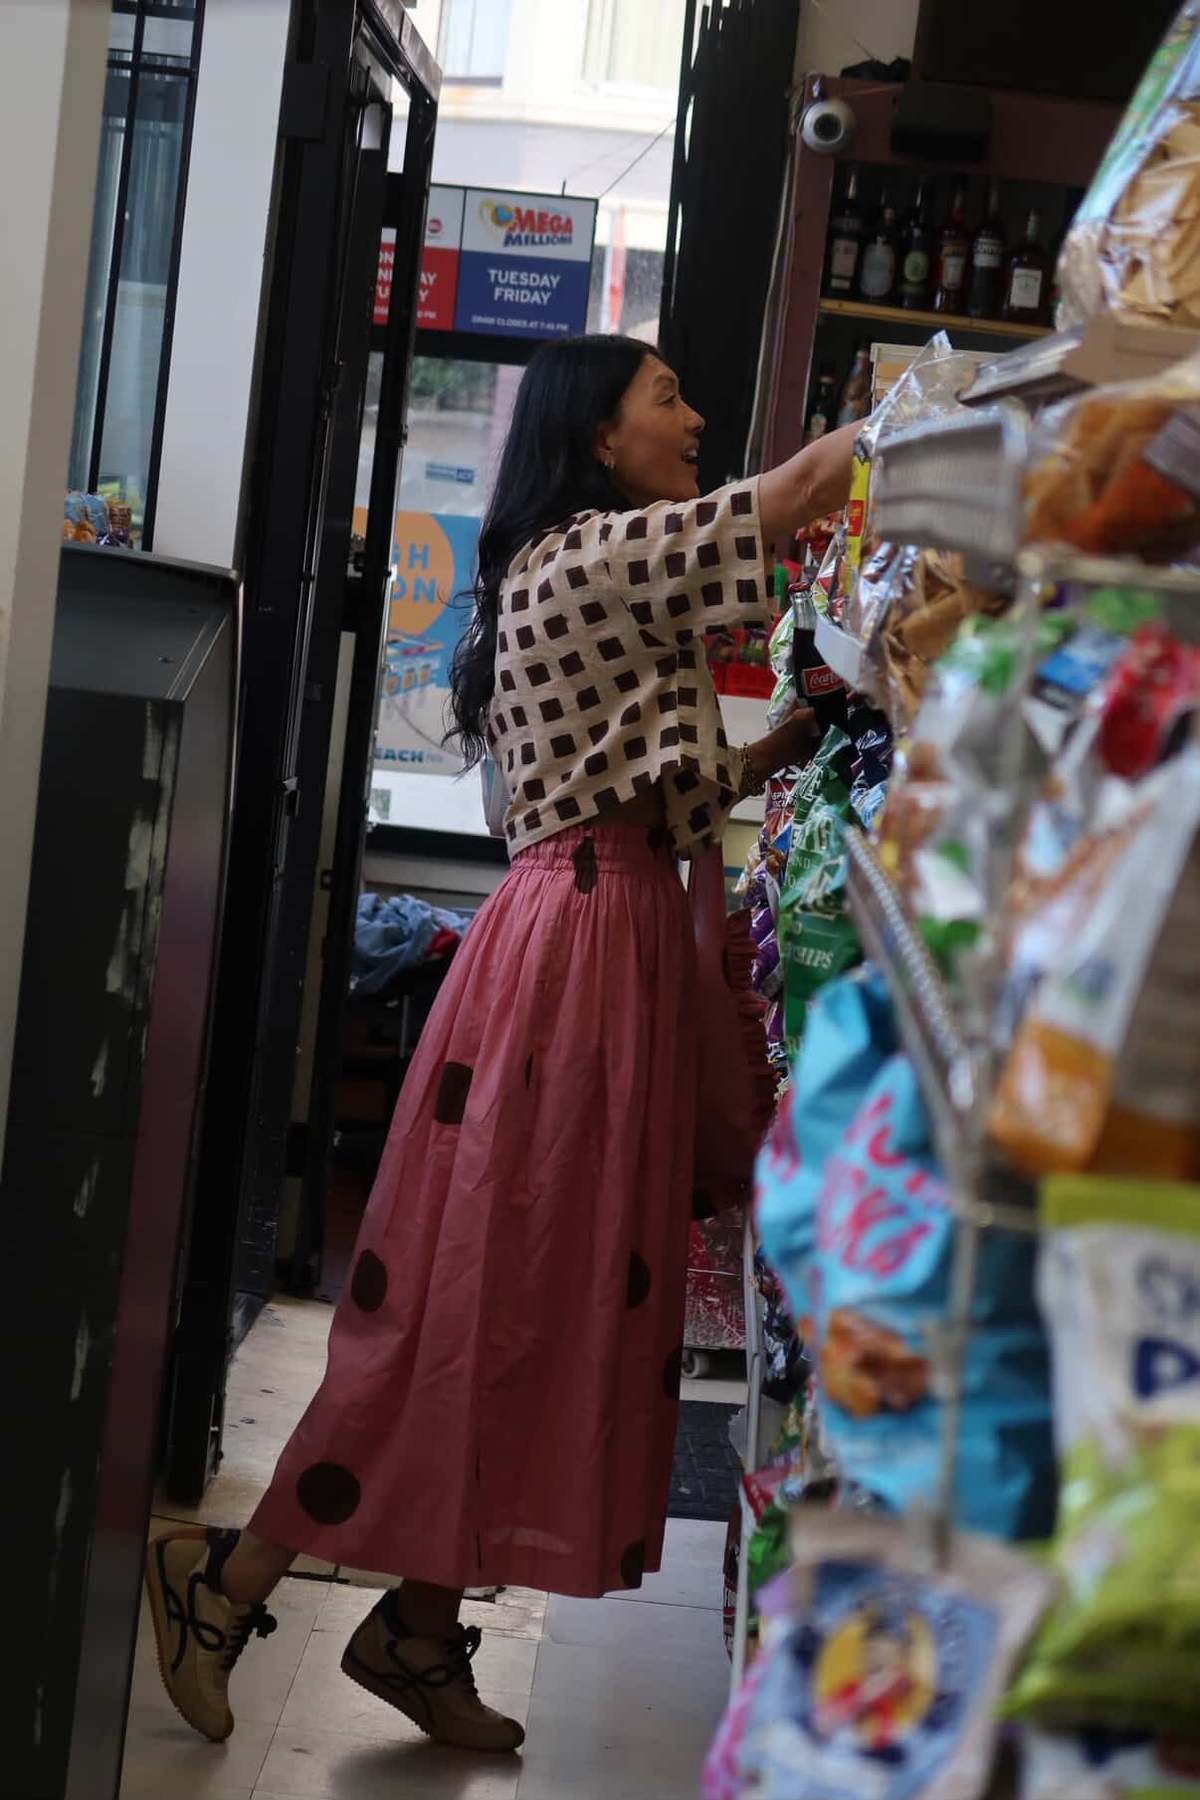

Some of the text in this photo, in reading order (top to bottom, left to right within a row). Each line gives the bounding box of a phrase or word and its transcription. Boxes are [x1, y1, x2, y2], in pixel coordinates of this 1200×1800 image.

[509, 207, 573, 234] MEGA
[504, 232, 573, 247] MILLIONS
[488, 269, 560, 289] TUESDAY
[494, 287, 552, 304] FRIDAY
[390, 576, 437, 604] ON
